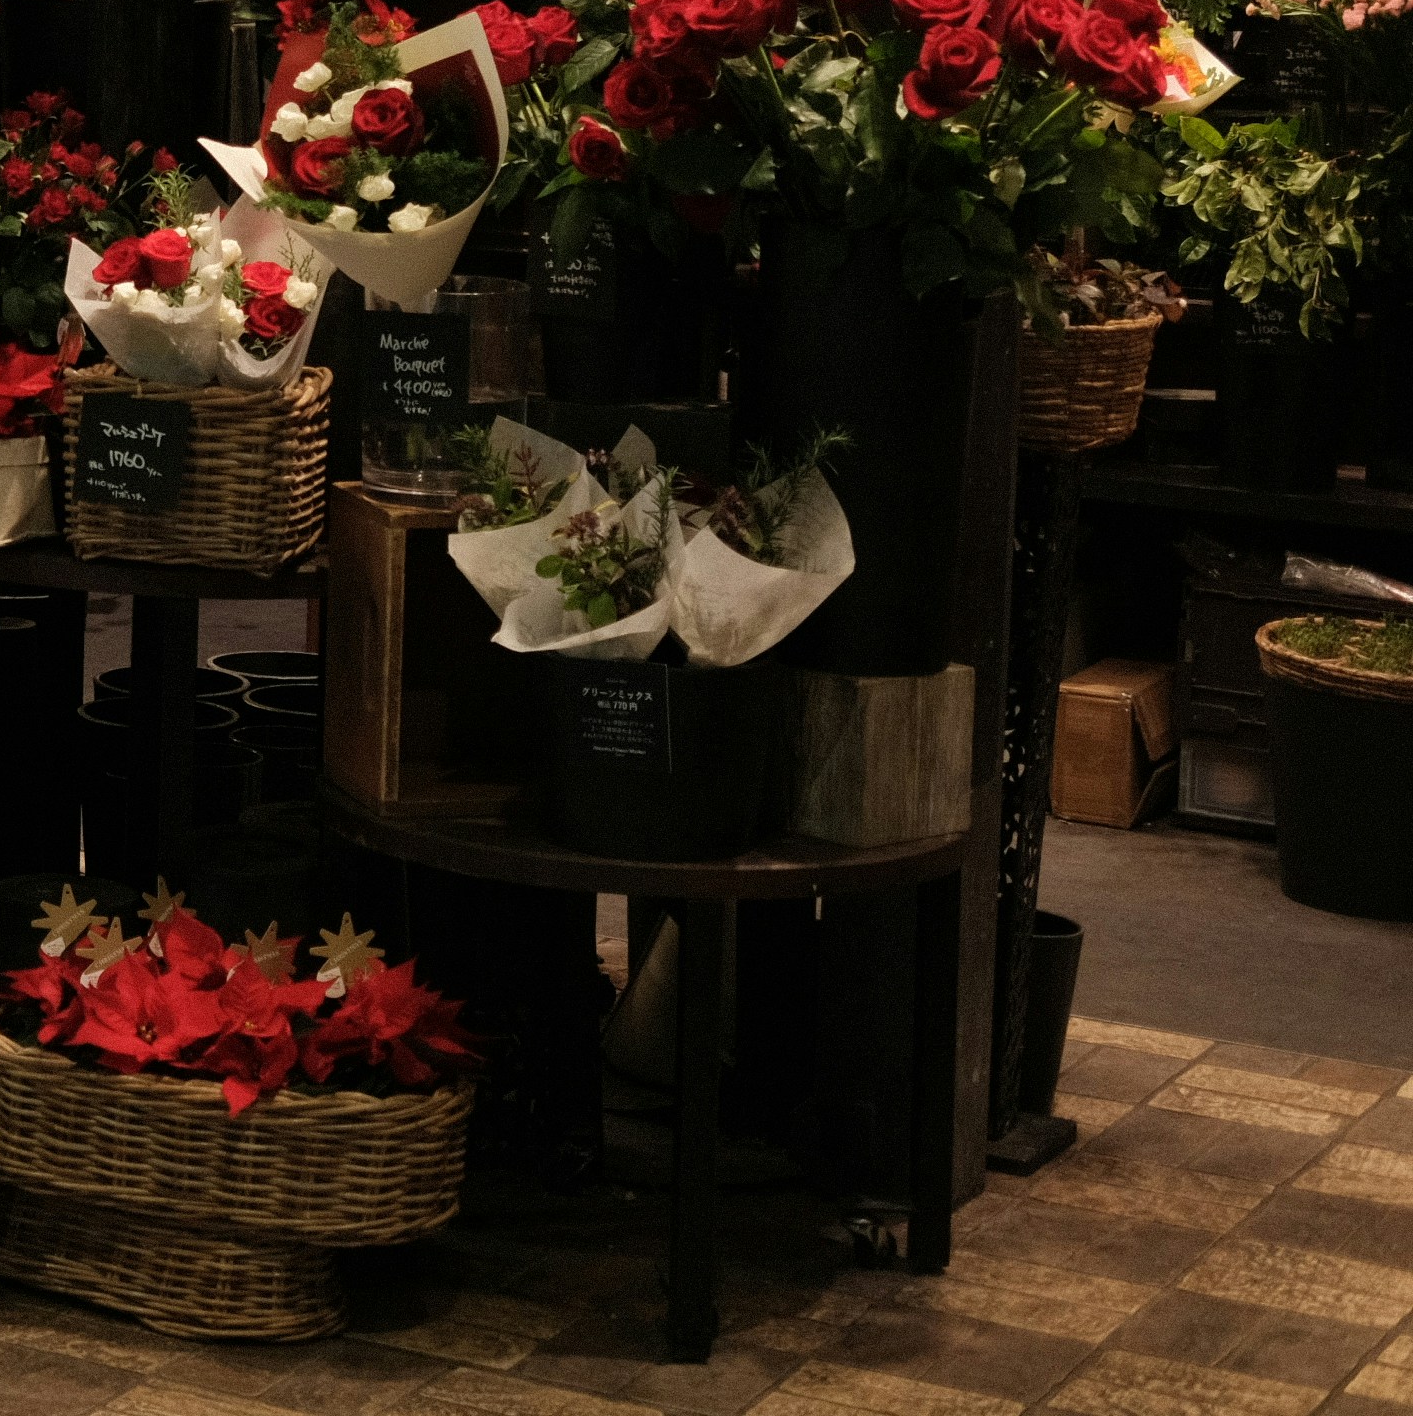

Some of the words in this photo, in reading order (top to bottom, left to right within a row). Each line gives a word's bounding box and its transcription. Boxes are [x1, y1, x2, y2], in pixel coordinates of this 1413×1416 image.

[393, 356, 447, 377] Bouquet
[393, 379, 432, 397] 4400
[109, 449, 146, 471] 1760
[582, 687, 653, 701] グリーンミックス
